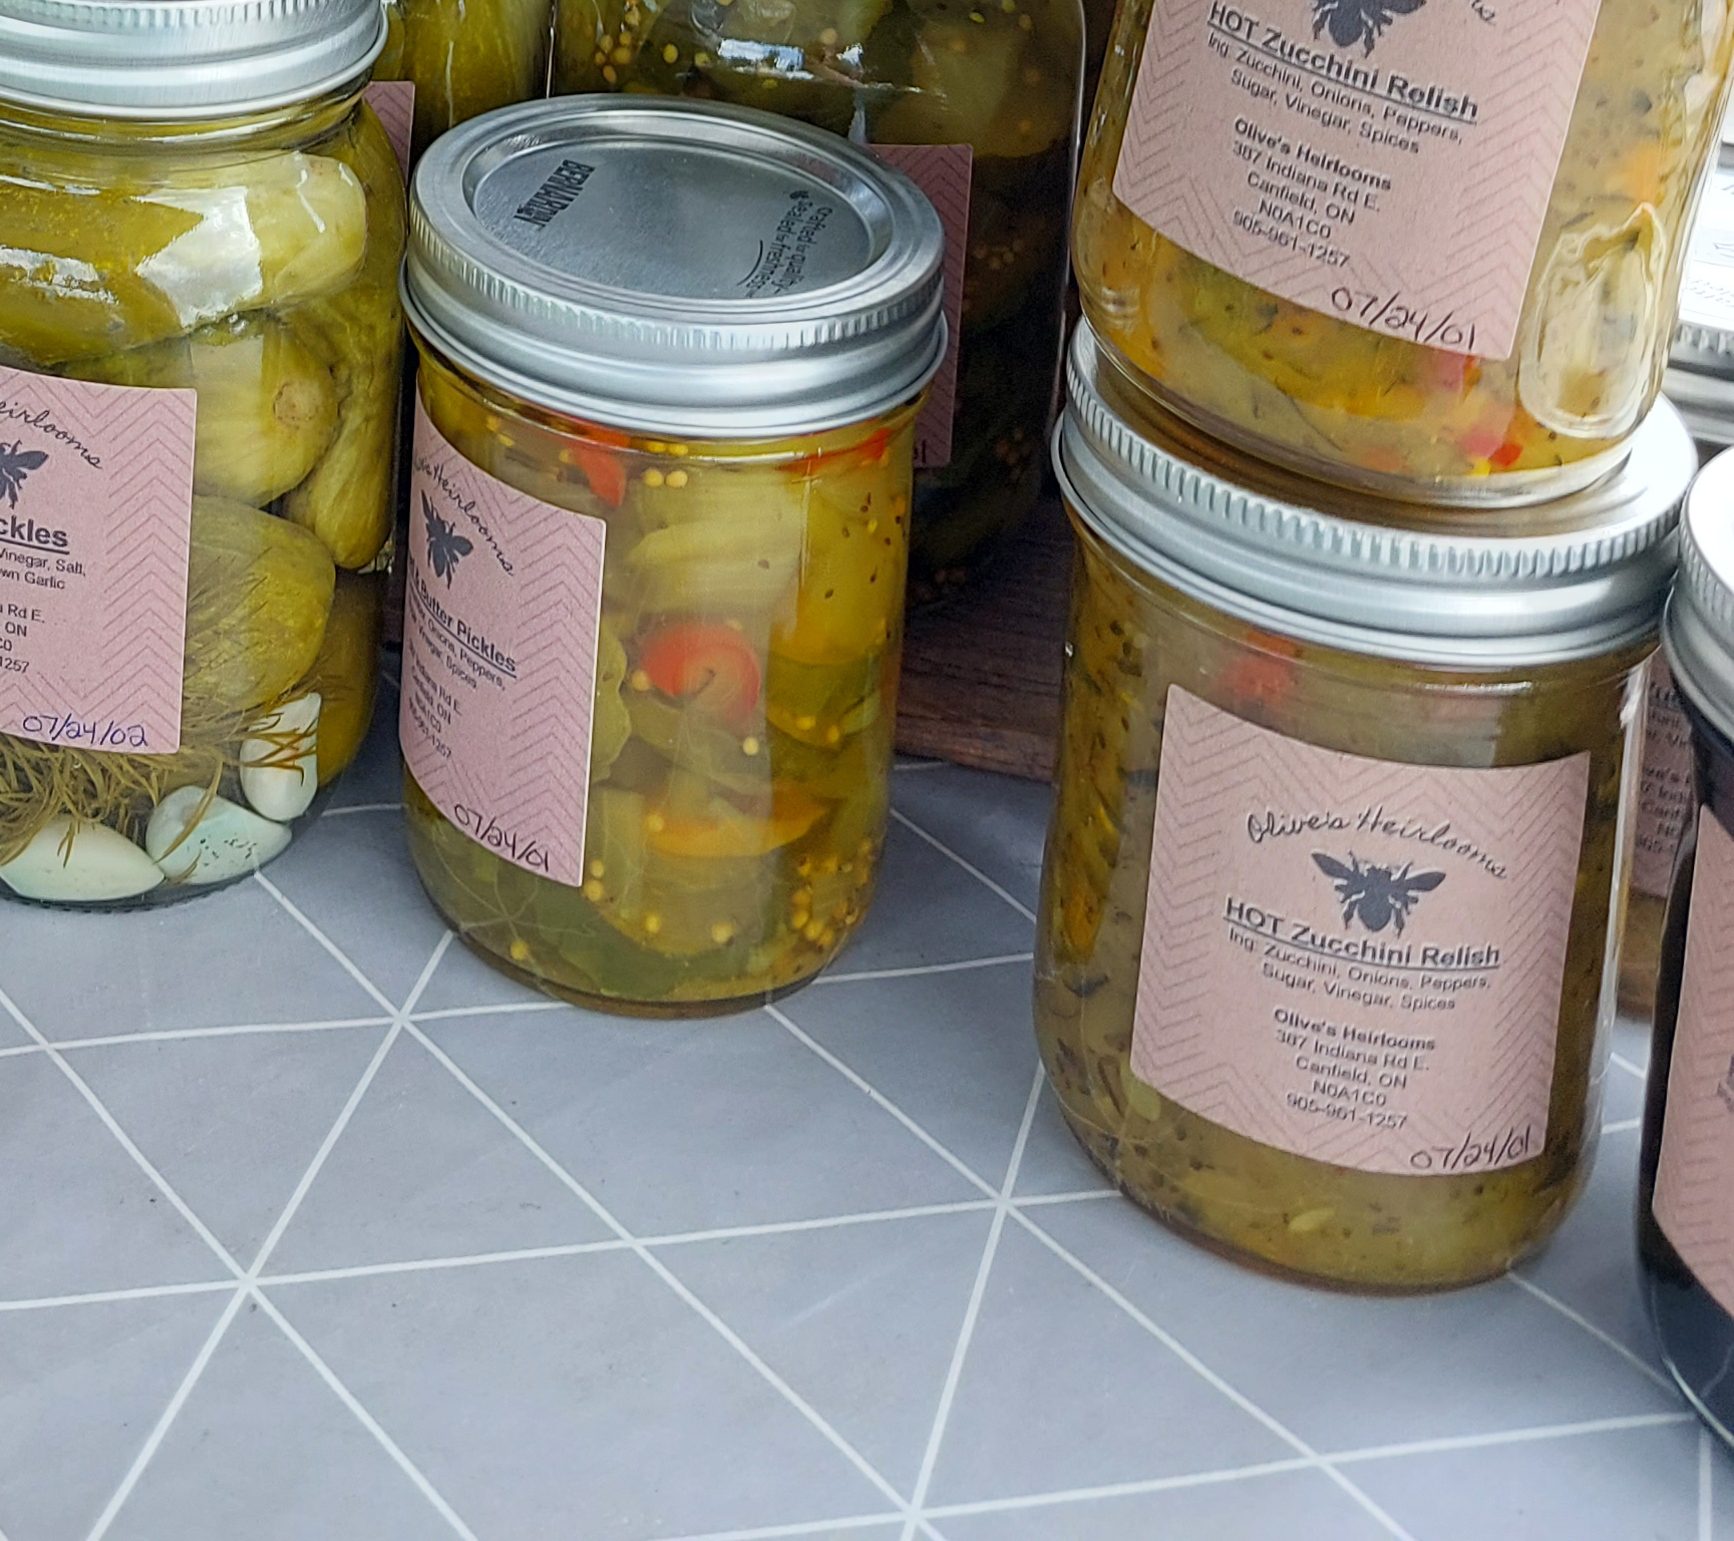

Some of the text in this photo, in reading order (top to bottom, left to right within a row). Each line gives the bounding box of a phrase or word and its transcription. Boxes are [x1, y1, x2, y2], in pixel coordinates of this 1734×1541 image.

[1209, 1, 1477, 117] HOT Zucchini Relish
[1296, 143, 1392, 191] Heirlooms
[1331, 287, 1475, 349] 07/24/01
[434, 463, 514, 576] Heirlooms
[24, 569, 65, 589] Garlic
[4, 622, 27, 637] ON
[7, 603, 27, 619] Rd
[421, 582, 453, 626] Butter
[457, 620, 516, 672] Pickles
[23, 711, 148, 747] 07/24/02
[455, 803, 548, 872] 07/24/01
[1359, 805, 1507, 881] Heirlooms
[1226, 897, 1499, 967] HOT Zucchini Relish
[1342, 1025, 1436, 1051] Heirlooms
[1410, 1124, 1531, 1169] 07/24/01
